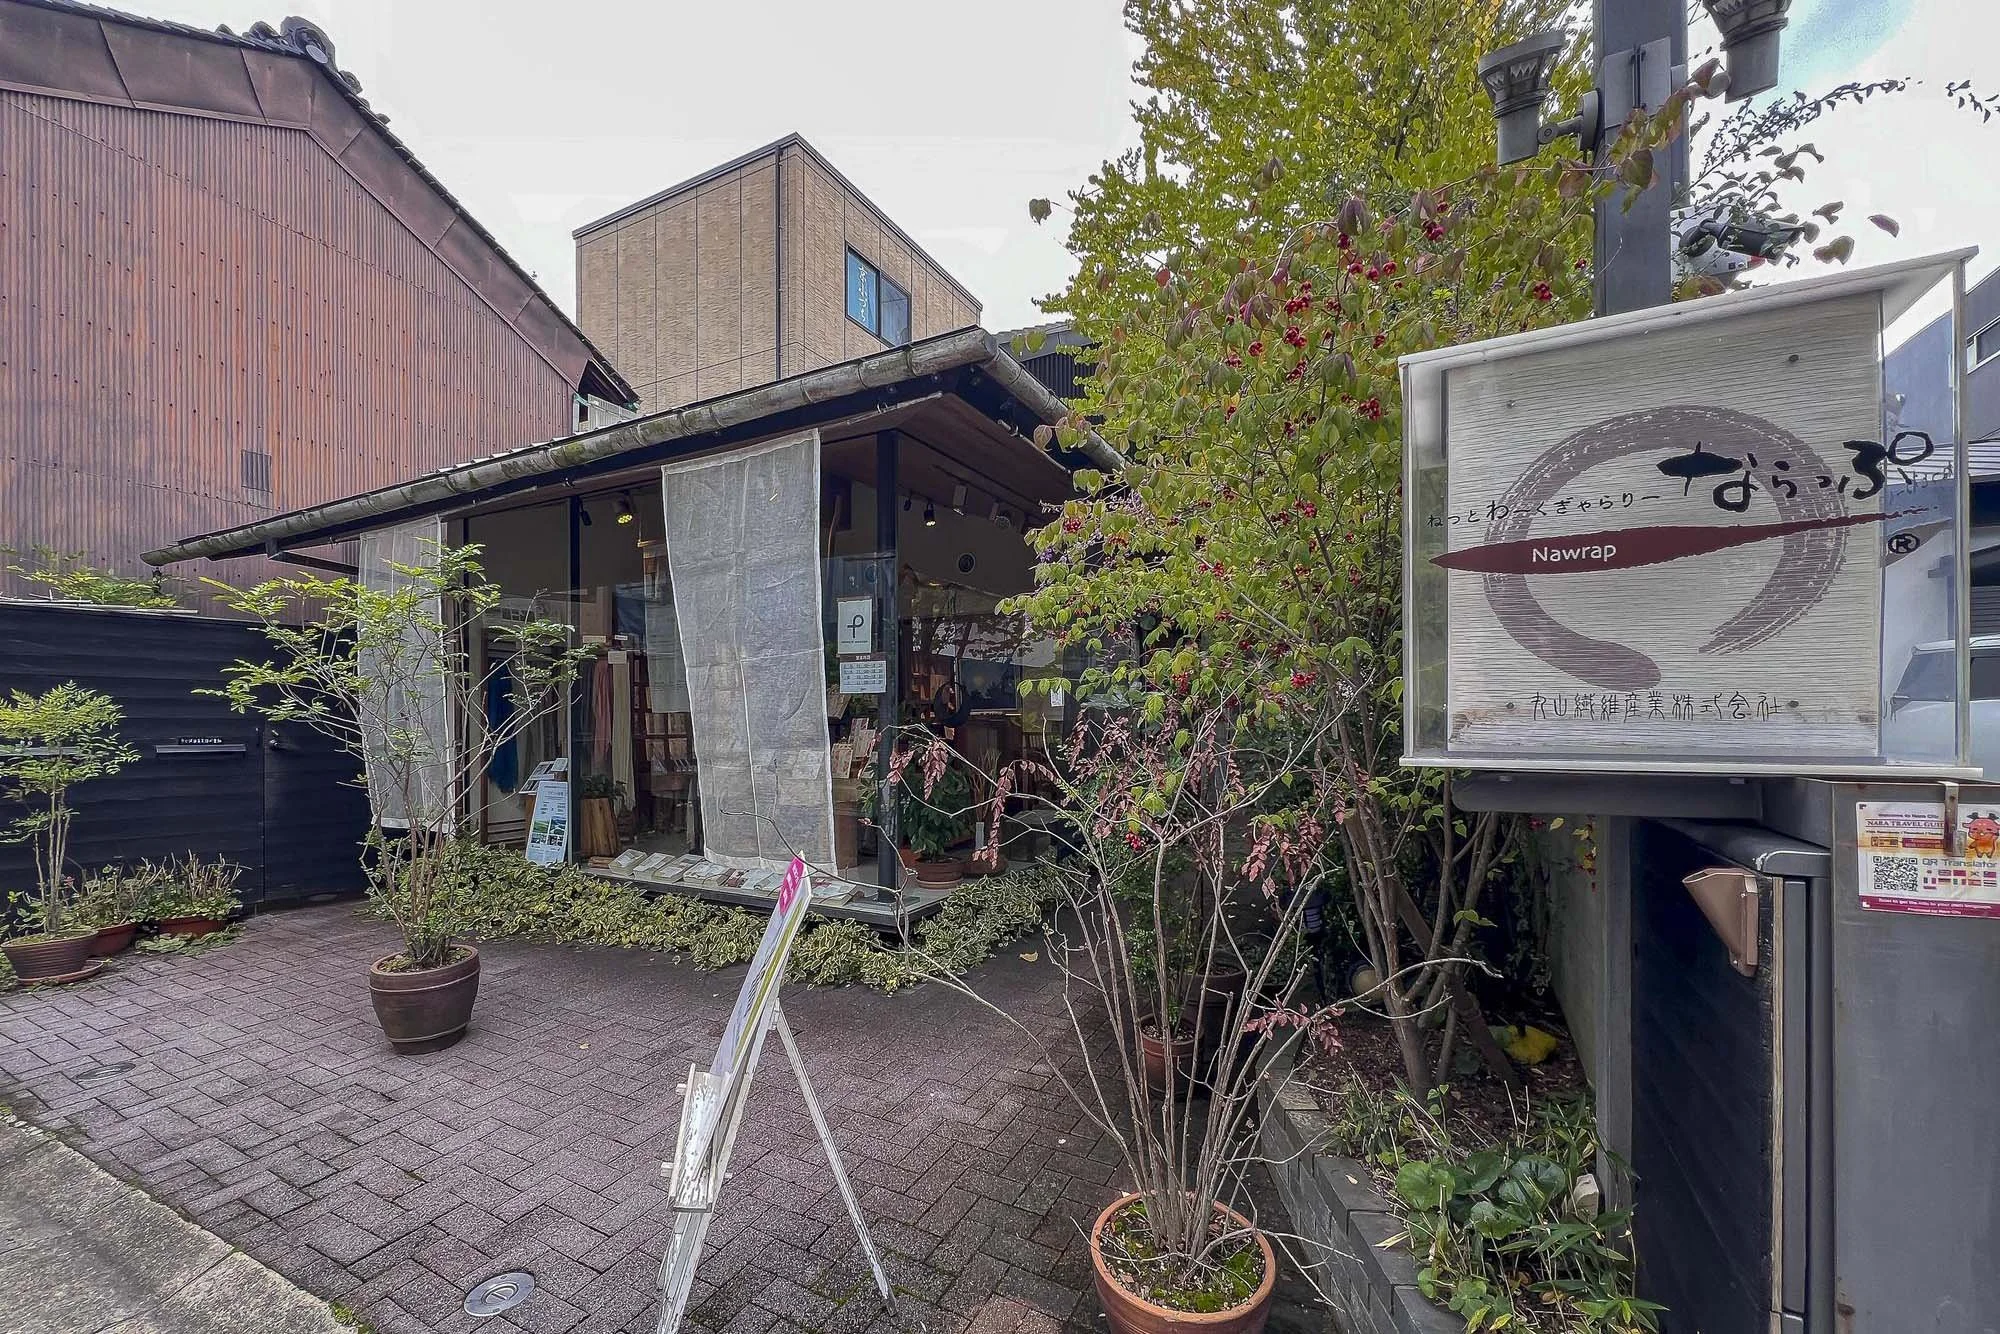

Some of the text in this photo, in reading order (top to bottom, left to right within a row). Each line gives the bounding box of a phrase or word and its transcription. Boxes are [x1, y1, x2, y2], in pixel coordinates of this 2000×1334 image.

[1427, 491, 1661, 528] ねっとわーくぎゃらりー
[1532, 543, 1617, 563] Nawrap
[1922, 858, 1998, 868] QR Translator
